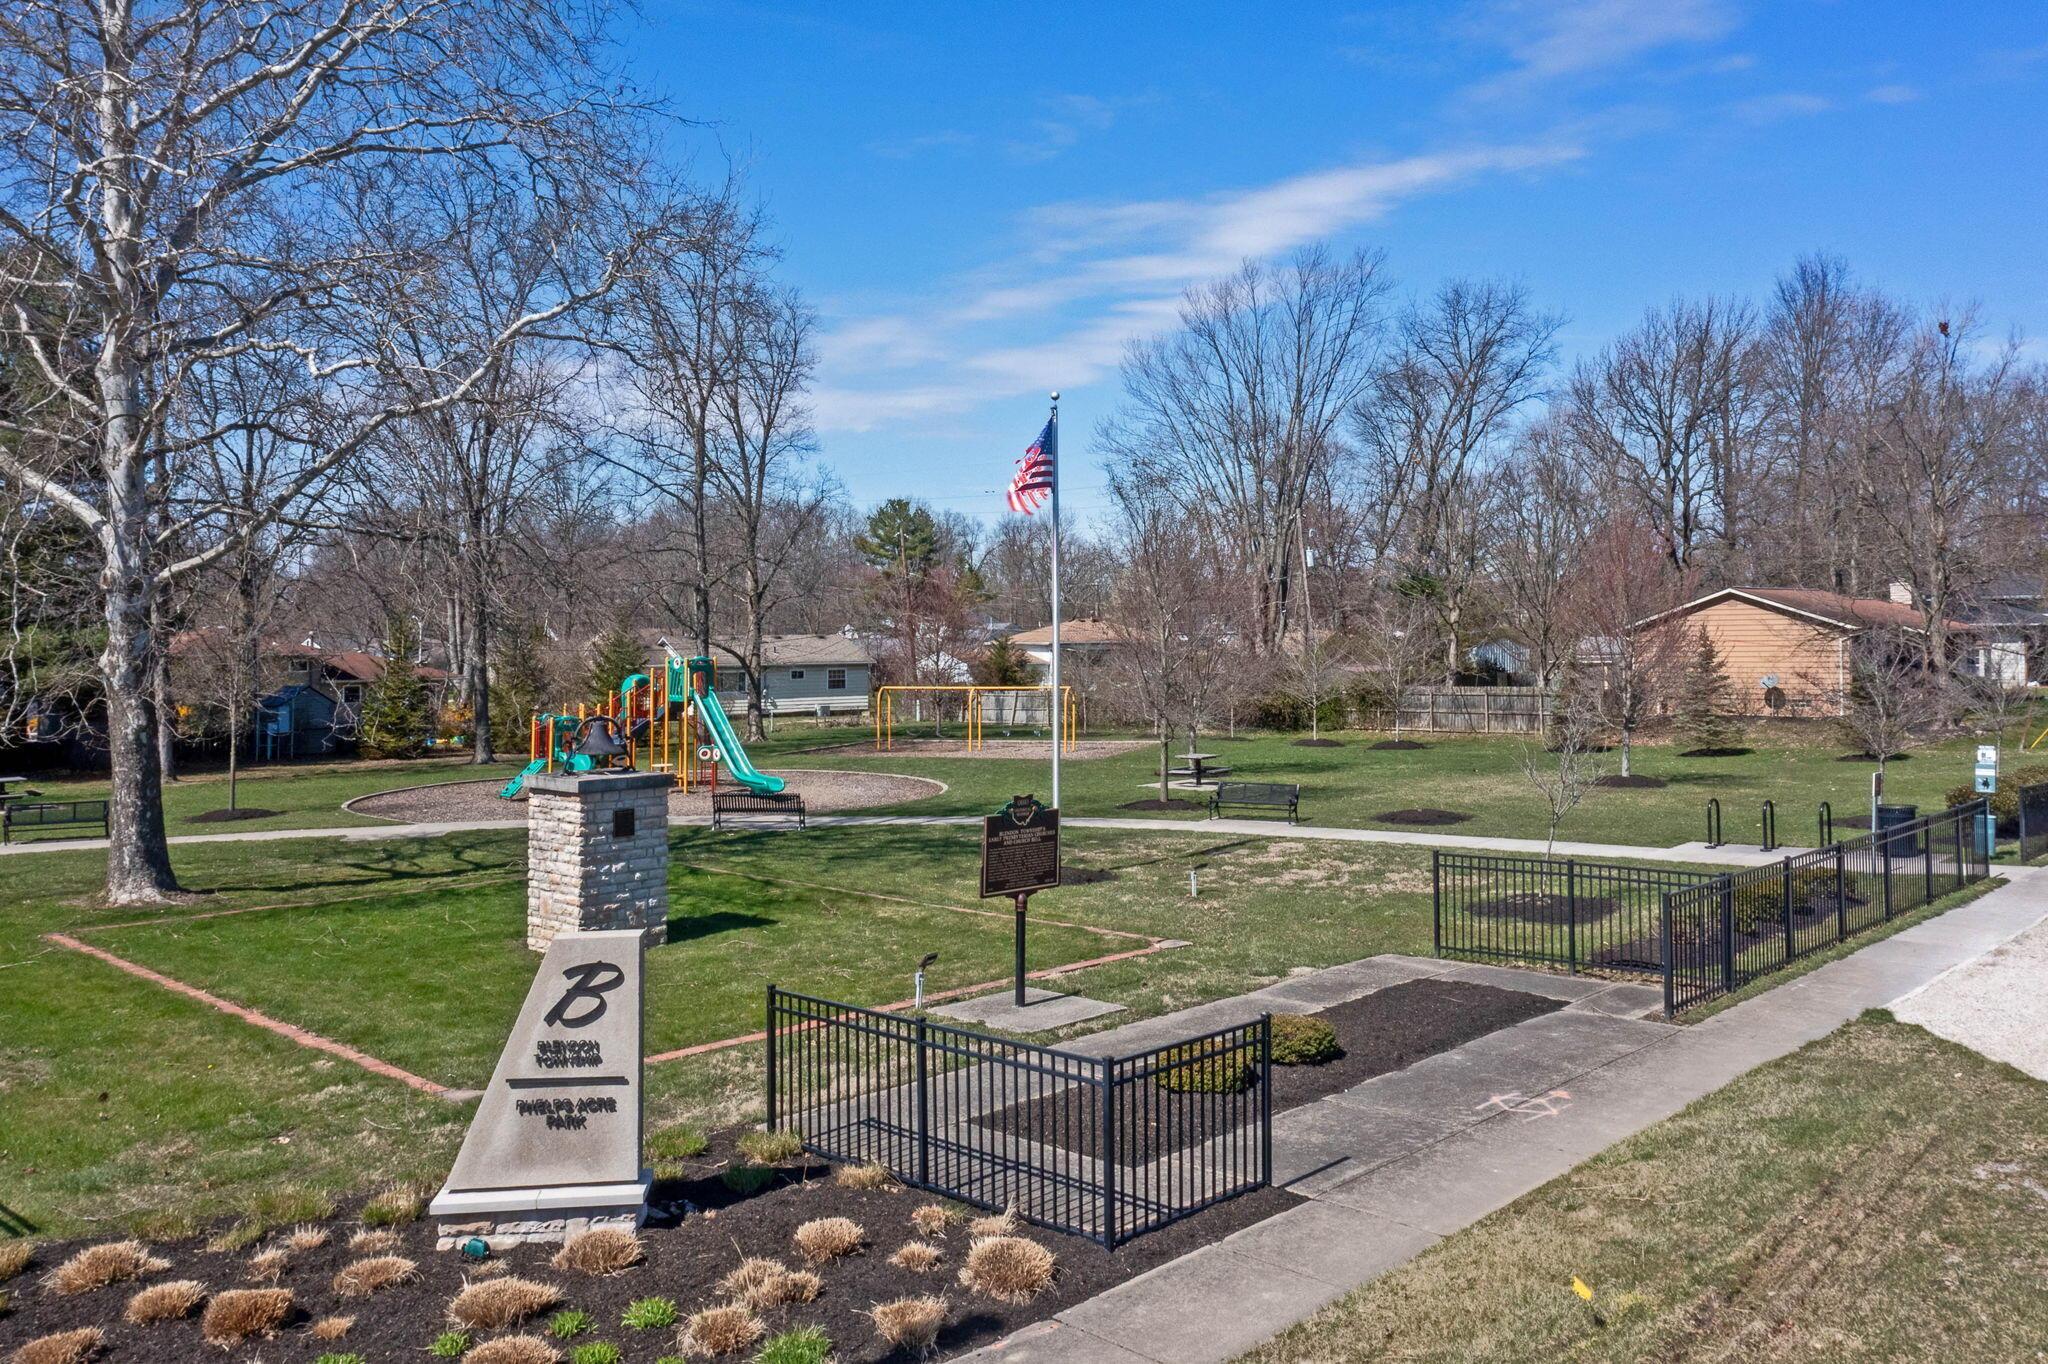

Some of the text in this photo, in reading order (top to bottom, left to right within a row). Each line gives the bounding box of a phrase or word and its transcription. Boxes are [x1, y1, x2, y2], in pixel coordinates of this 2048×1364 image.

[544, 960, 625, 1028] B
[537, 1039, 601, 1055] BLENDON
[533, 1051, 603, 1069] TOWNSHIP
[516, 1097, 617, 1116] PHELPS ACRE
[546, 1114, 587, 1131] PARK
